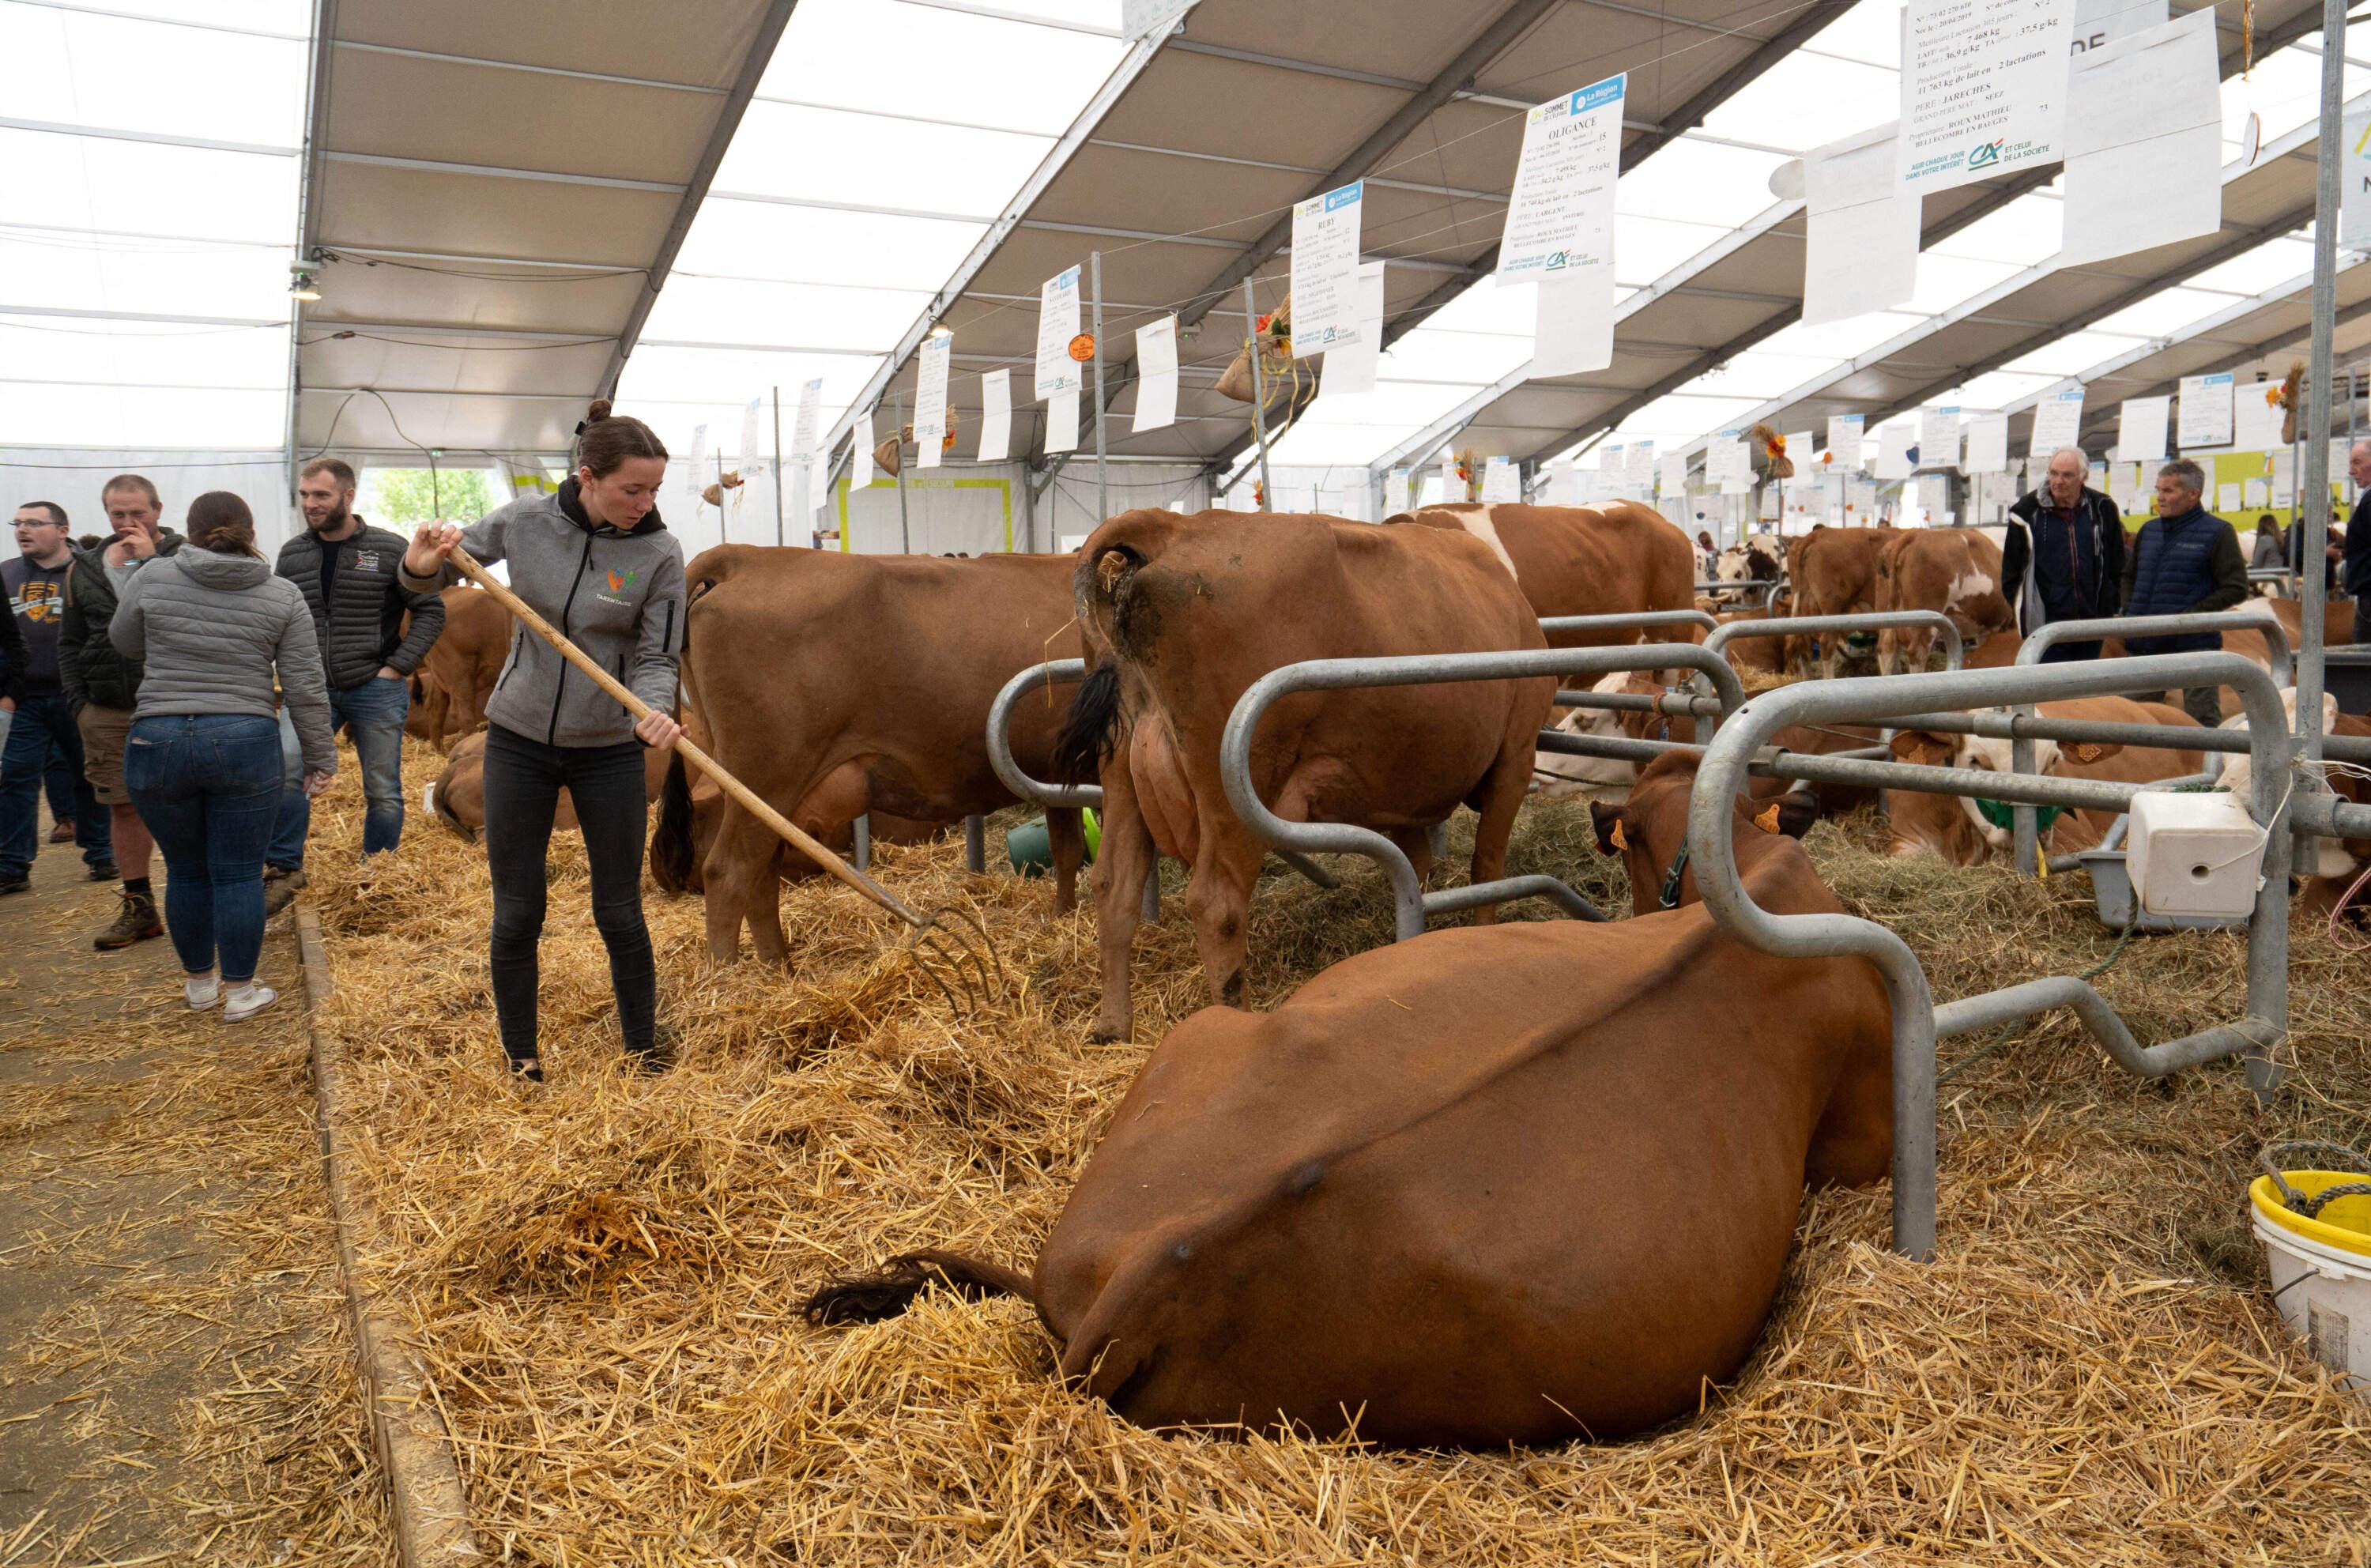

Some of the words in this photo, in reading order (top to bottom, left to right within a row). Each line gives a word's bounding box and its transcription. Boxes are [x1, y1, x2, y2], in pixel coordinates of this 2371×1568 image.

[1989, 28, 2000, 38] kg
[1943, 79, 1954, 89] kg
[1966, 69, 1980, 81] lait
[1999, 61, 2005, 70] 2
[2006, 50, 2047, 68] lactations
[1942, 82, 1992, 104] JARECHES
[1973, 104, 2011, 122] MATHIEU
[1548, 116, 1596, 141] OLIGANCE
[1977, 115, 2009, 130] BAUGES
[2004, 145, 2014, 154] ET
[2013, 140, 2032, 152] CELUI
[2014, 152, 2023, 161] LA
[1905, 171, 1921, 181] DANS
